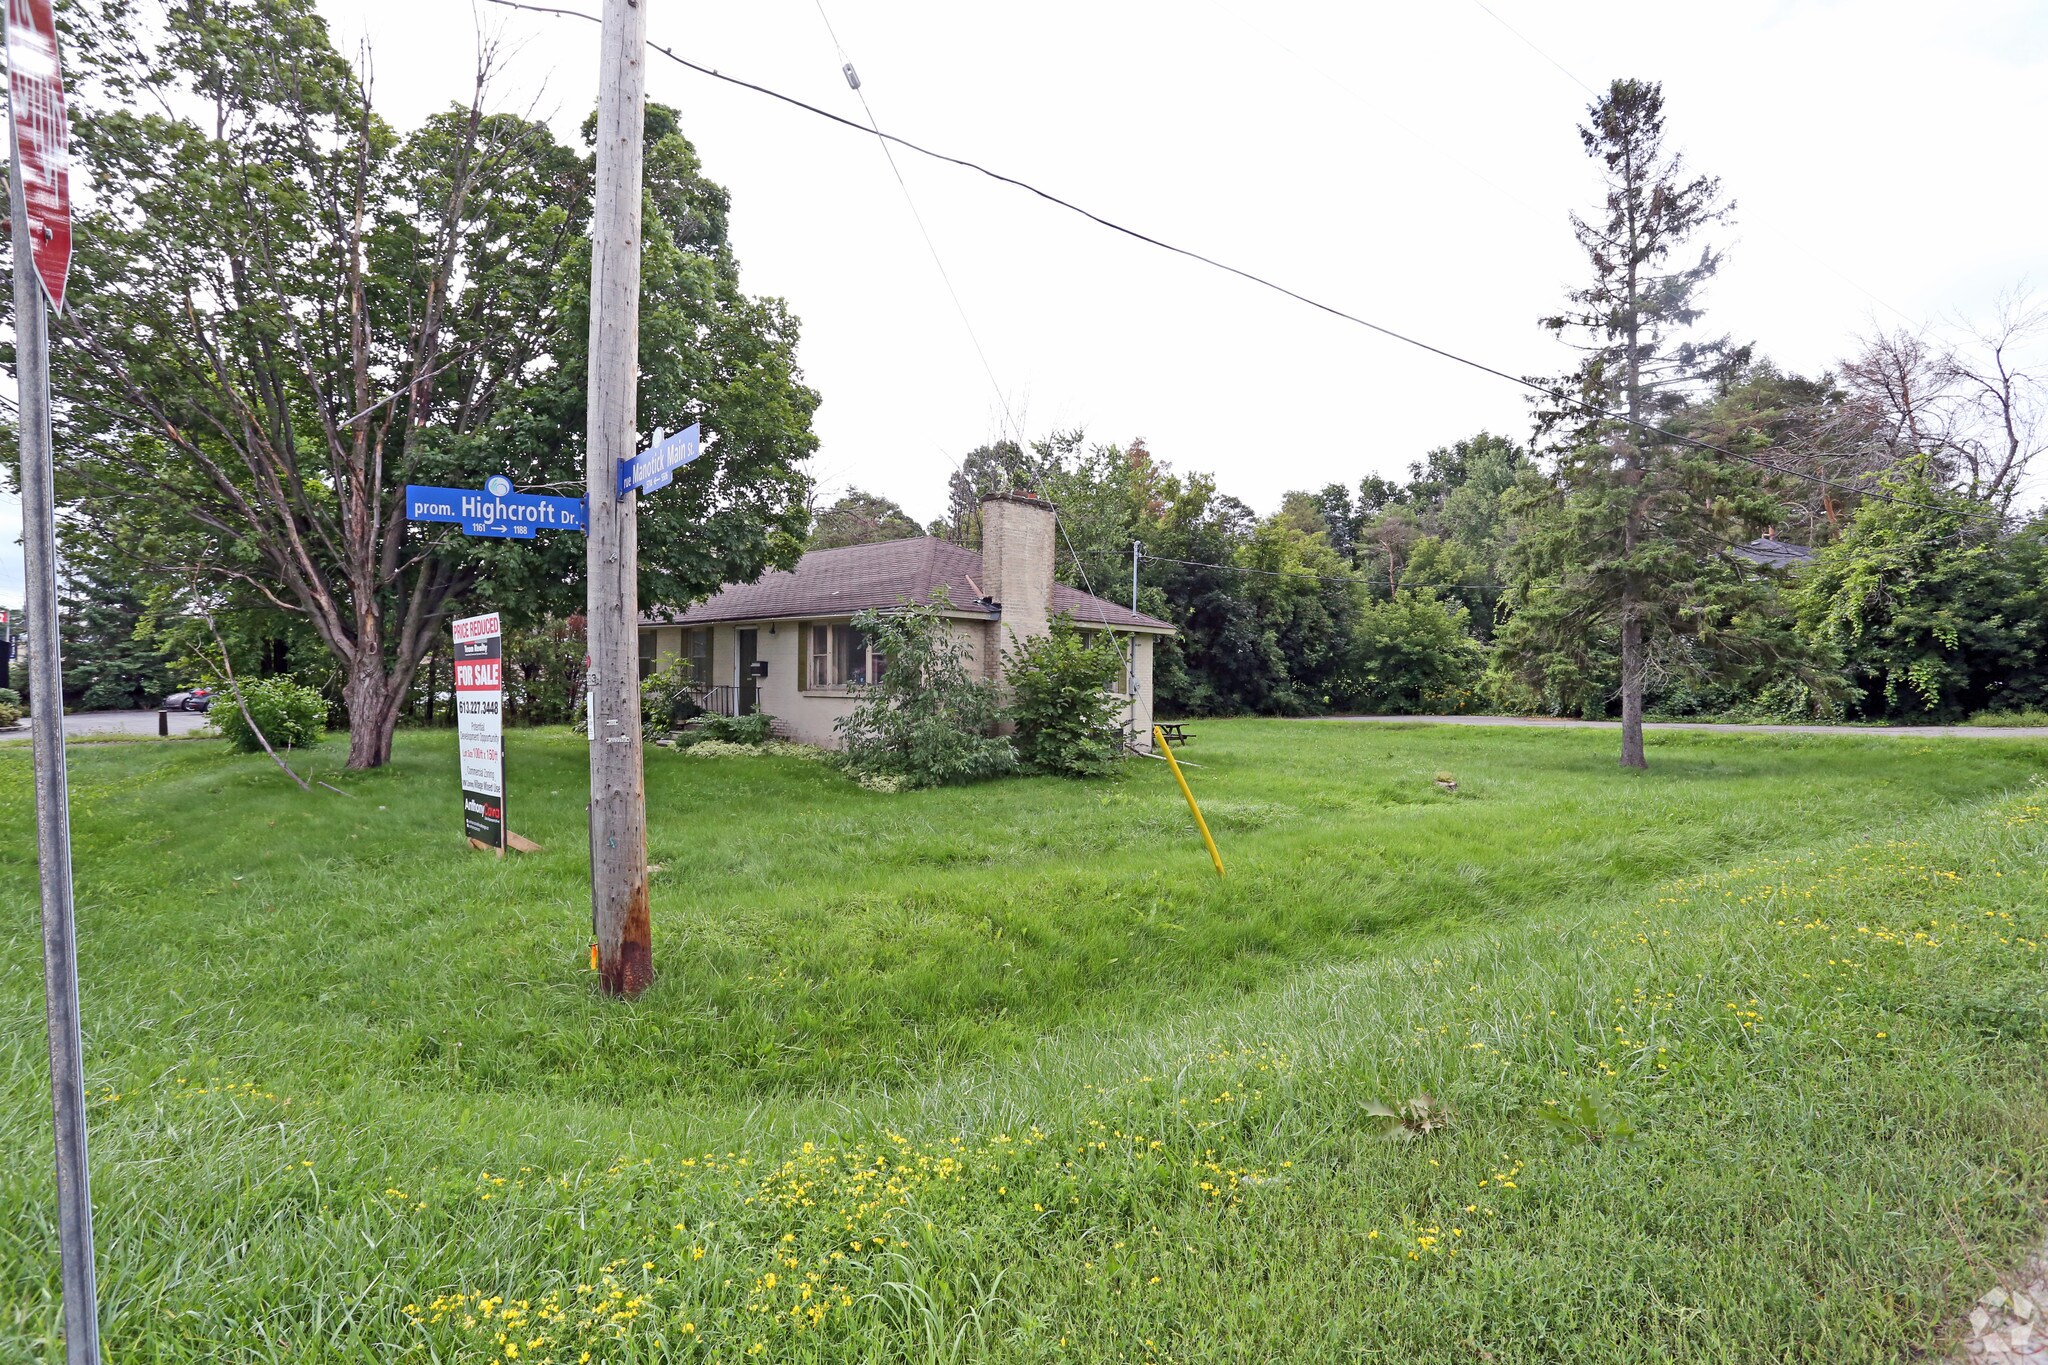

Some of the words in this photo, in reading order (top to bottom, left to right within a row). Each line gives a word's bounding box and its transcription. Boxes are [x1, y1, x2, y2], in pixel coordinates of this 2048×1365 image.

[623, 476, 631, 489] rue
[632, 449, 665, 485] Manotick
[667, 440, 686, 468] Main
[414, 501, 455, 518] prom.
[462, 496, 555, 525] Highcroft
[560, 510, 579, 525] Dr.
[472, 522, 486, 533] 1161
[513, 525, 528, 535] 1188
[454, 622, 470, 640] PRICE
[470, 617, 499, 638] REDUCED
[457, 665, 474, 686] FOR
[474, 664, 499, 686] SALE
[459, 701, 499, 715] 613.227.3448
[480, 732, 499, 745] Opportunity
[467, 766, 483, 778] Commercial
